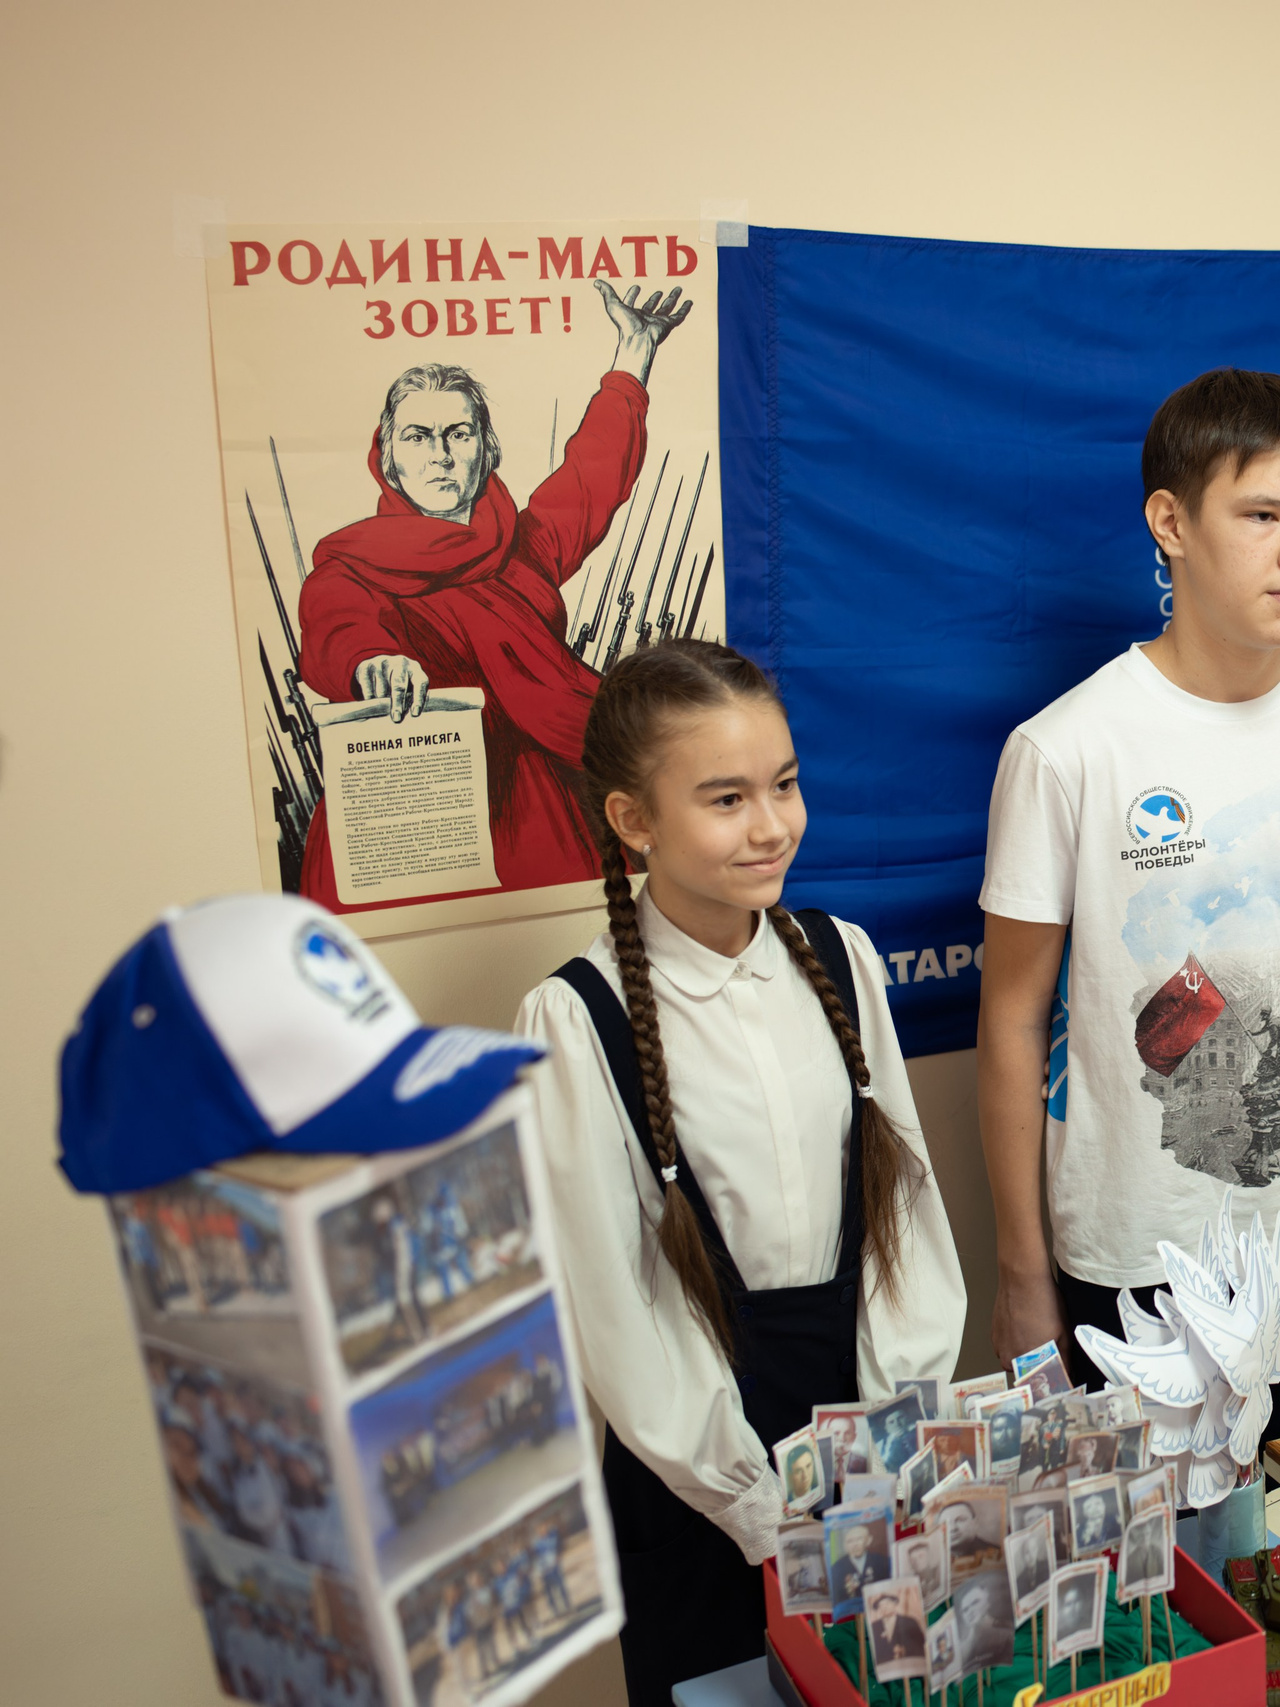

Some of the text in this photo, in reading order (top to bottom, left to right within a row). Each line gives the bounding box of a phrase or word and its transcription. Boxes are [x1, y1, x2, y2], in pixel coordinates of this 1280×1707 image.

[229, 235, 699, 290] РОДИНА-МАТЬ
[362, 296, 573, 340] ЗОВЕТ!
[347, 732, 461, 754] ВОЕННАЯ ПРИСЯГА
[1125, 785, 1194, 845] ВСЕРОССИЙСКОЕ ОБЩЕСТВЕННОЕ ДВИЖЕНИЕ
[1120, 839, 1206, 861] ВОЛОНТЁРЫ
[1135, 854, 1195, 871] ПОБЕДЫ
